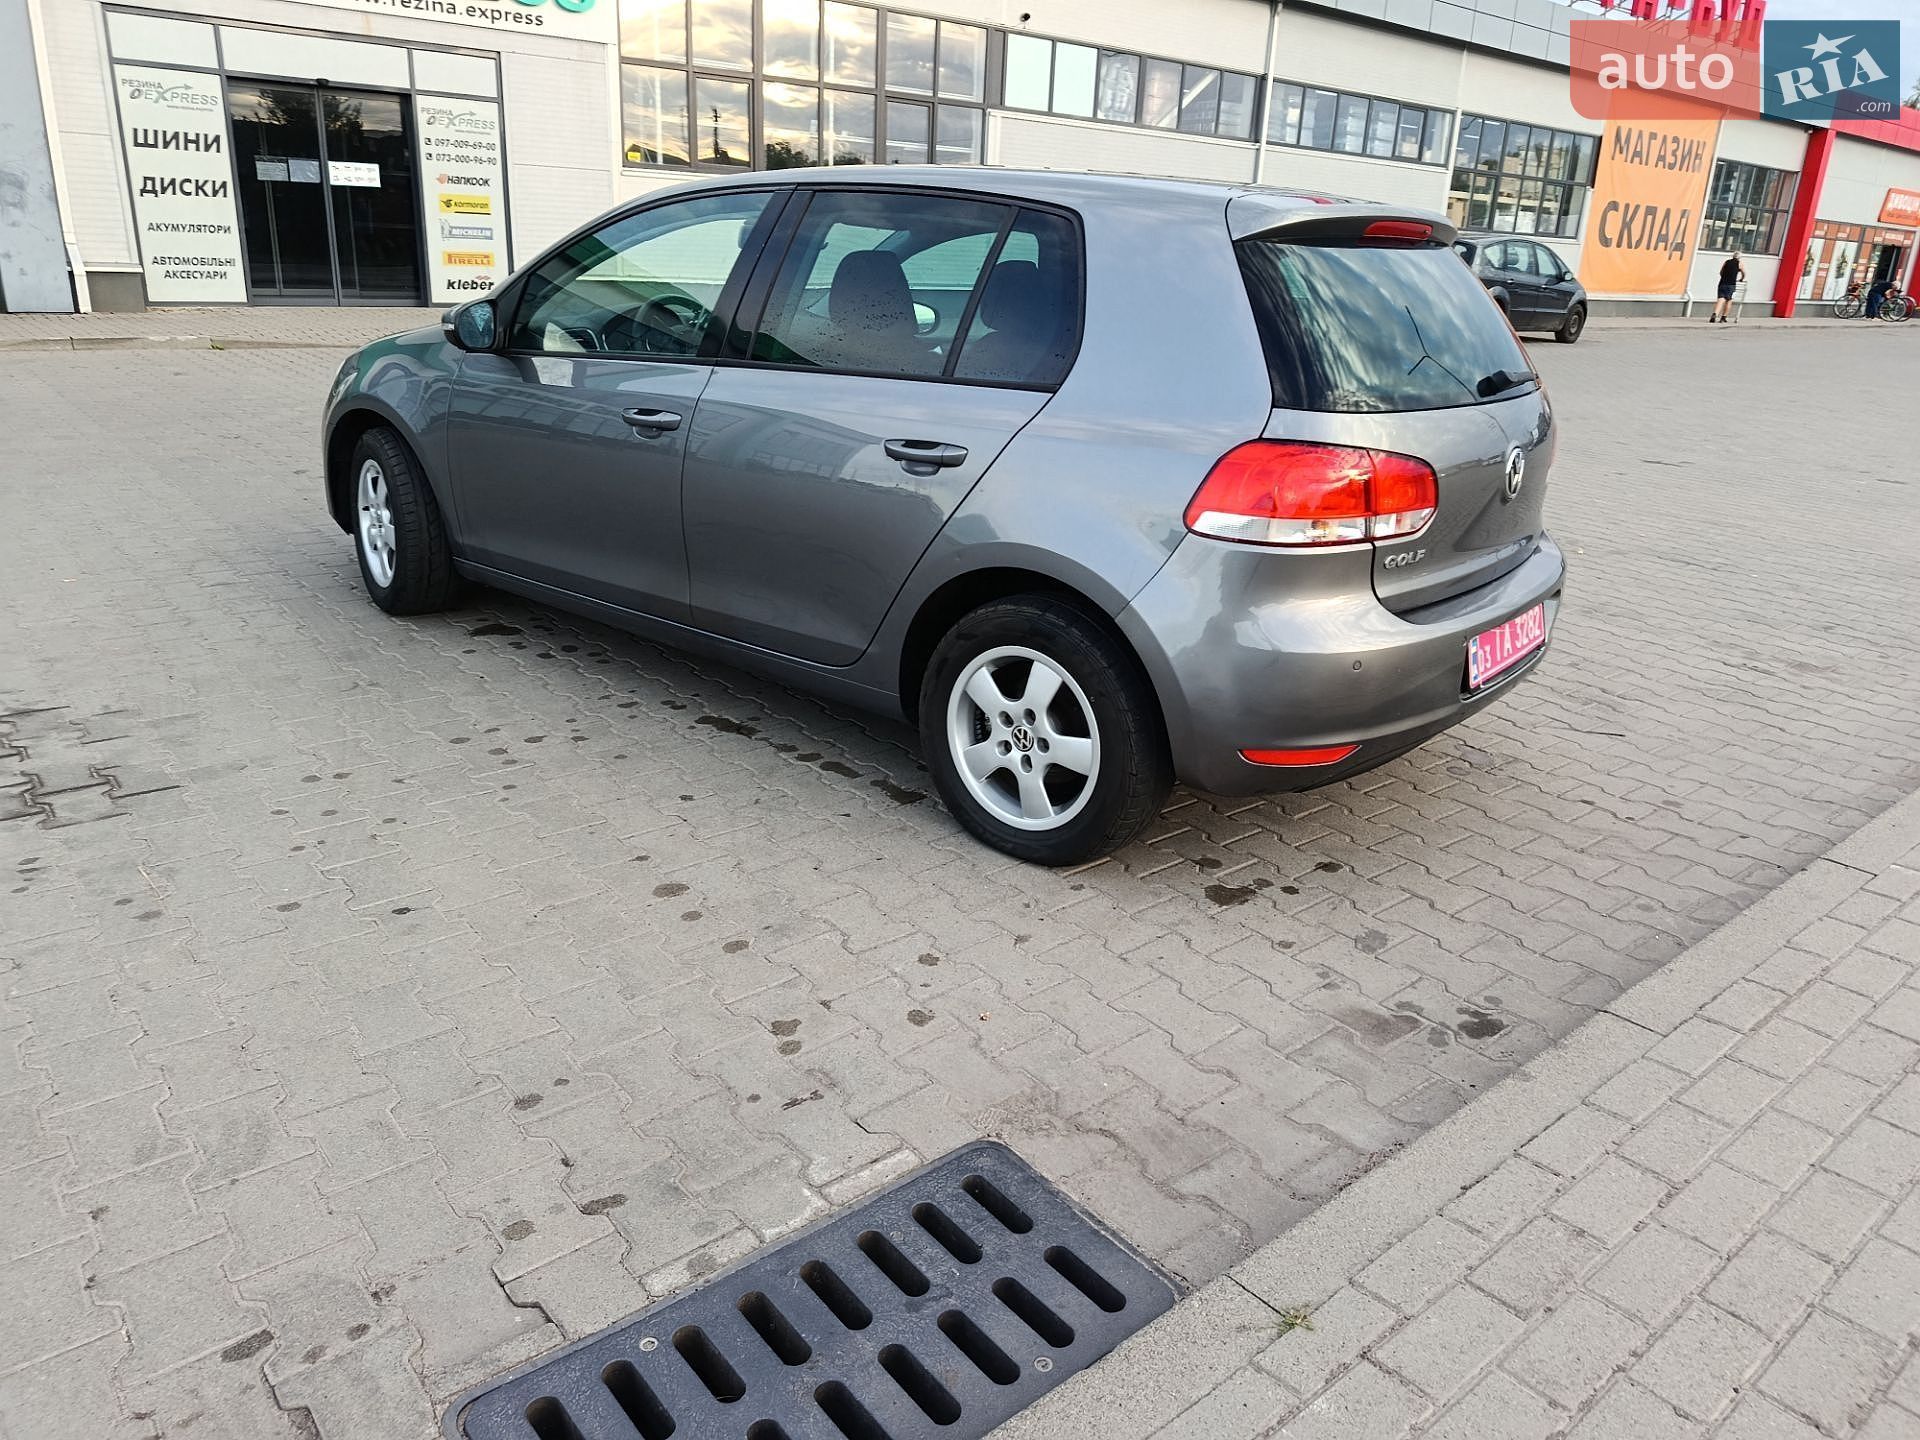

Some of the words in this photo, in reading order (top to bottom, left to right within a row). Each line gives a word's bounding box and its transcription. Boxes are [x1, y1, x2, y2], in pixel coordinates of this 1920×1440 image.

[121, 79, 163, 90] РЕЗИНА
[421, 107, 453, 116] РЕЗИНА
[132, 127, 221, 153] ШИНИ
[1611, 125, 1706, 173] МАГАЗИН
[140, 176, 228, 198] ДИСКИ
[147, 222, 231, 234] АКУМУЛЯТОРИ
[452, 227, 492, 237] MICHELIN
[1598, 200, 1691, 261] СКЛАД
[152, 256, 236, 267] АВТОМОБІЛЬНІ
[448, 253, 491, 265] PIRELLI
[163, 270, 227, 280] АКСЕСУАРИ
[446, 279, 494, 290] kleber
[1383, 549, 1426, 569] GOLF
[1514, 606, 1541, 648] 3282
